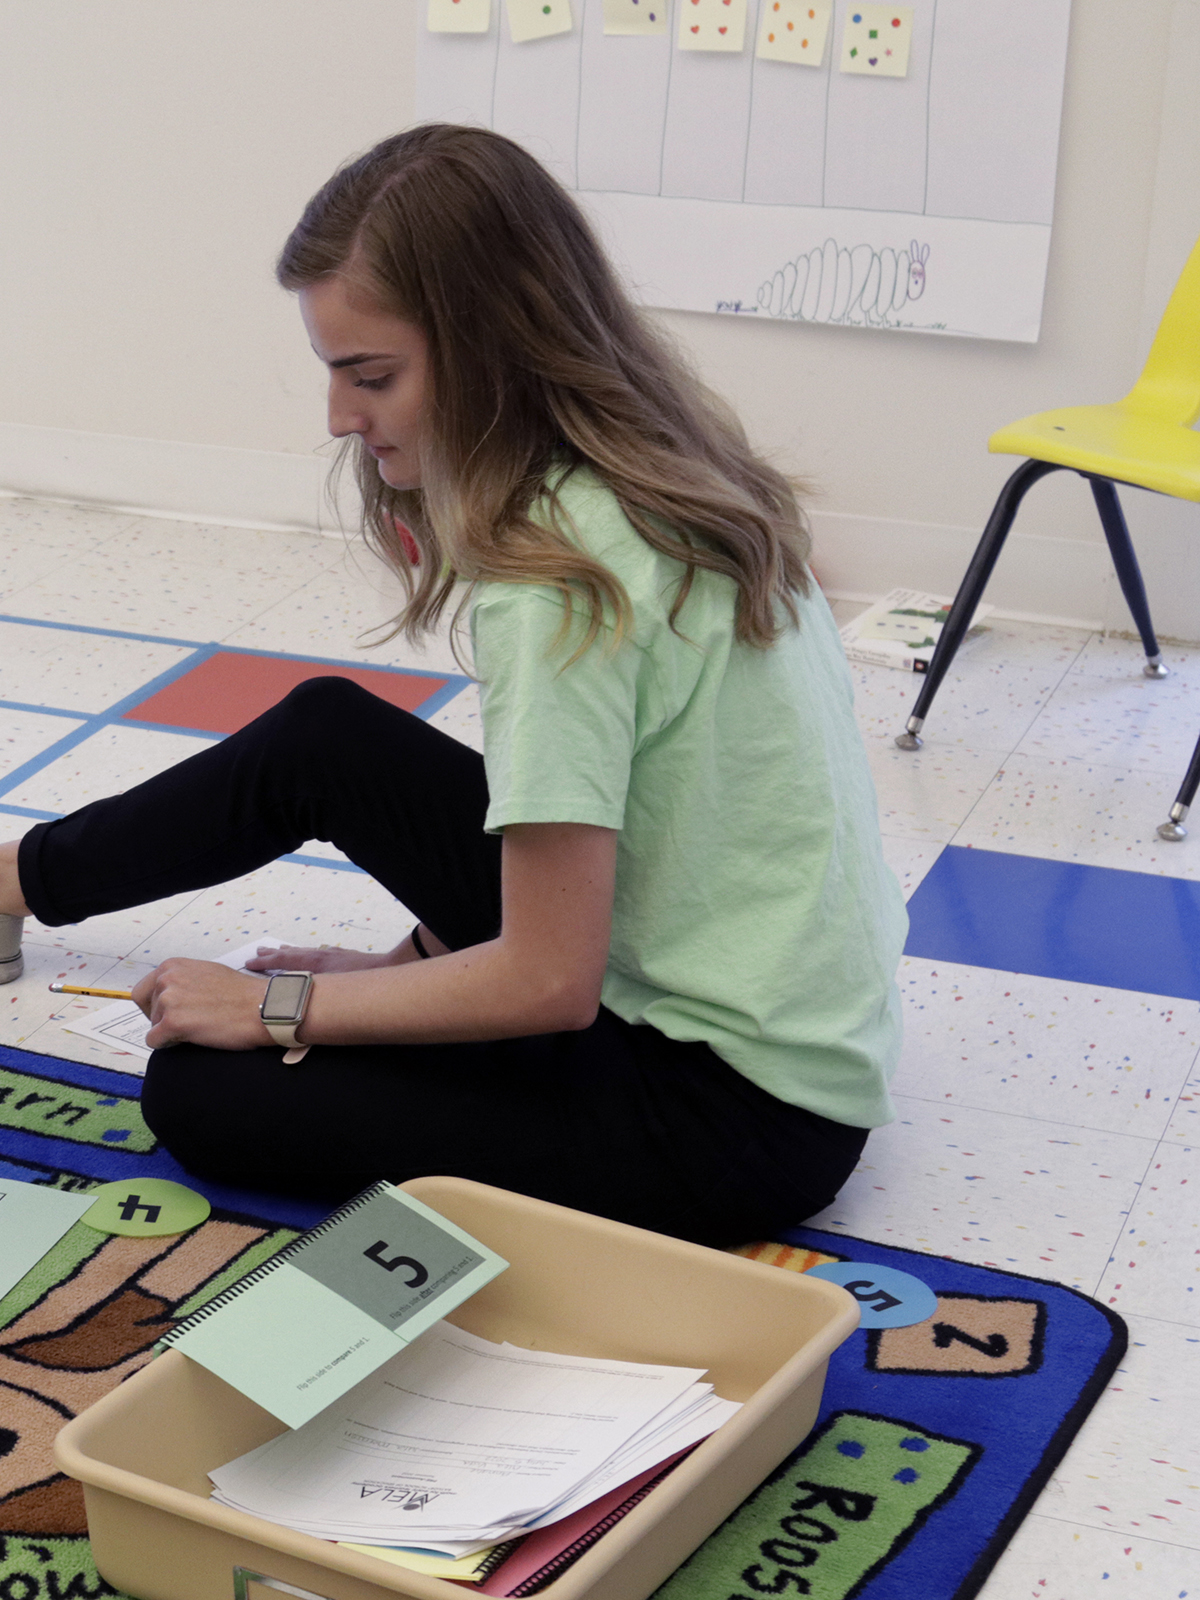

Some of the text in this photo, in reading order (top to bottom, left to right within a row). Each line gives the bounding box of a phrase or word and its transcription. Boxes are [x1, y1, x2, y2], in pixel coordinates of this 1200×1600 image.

[117, 1194, 162, 1223] 4
[363, 1240, 428, 1288] 5
[419, 1287, 434, 1300] after
[431, 1267, 458, 1289] comparing
[842, 1280, 903, 1312] 5
[933, 1322, 1009, 1358] 2
[331, 1349, 353, 1366] compare
[360, 1486, 440, 1505] MELA
[727, 1480, 878, 1600] Roos
